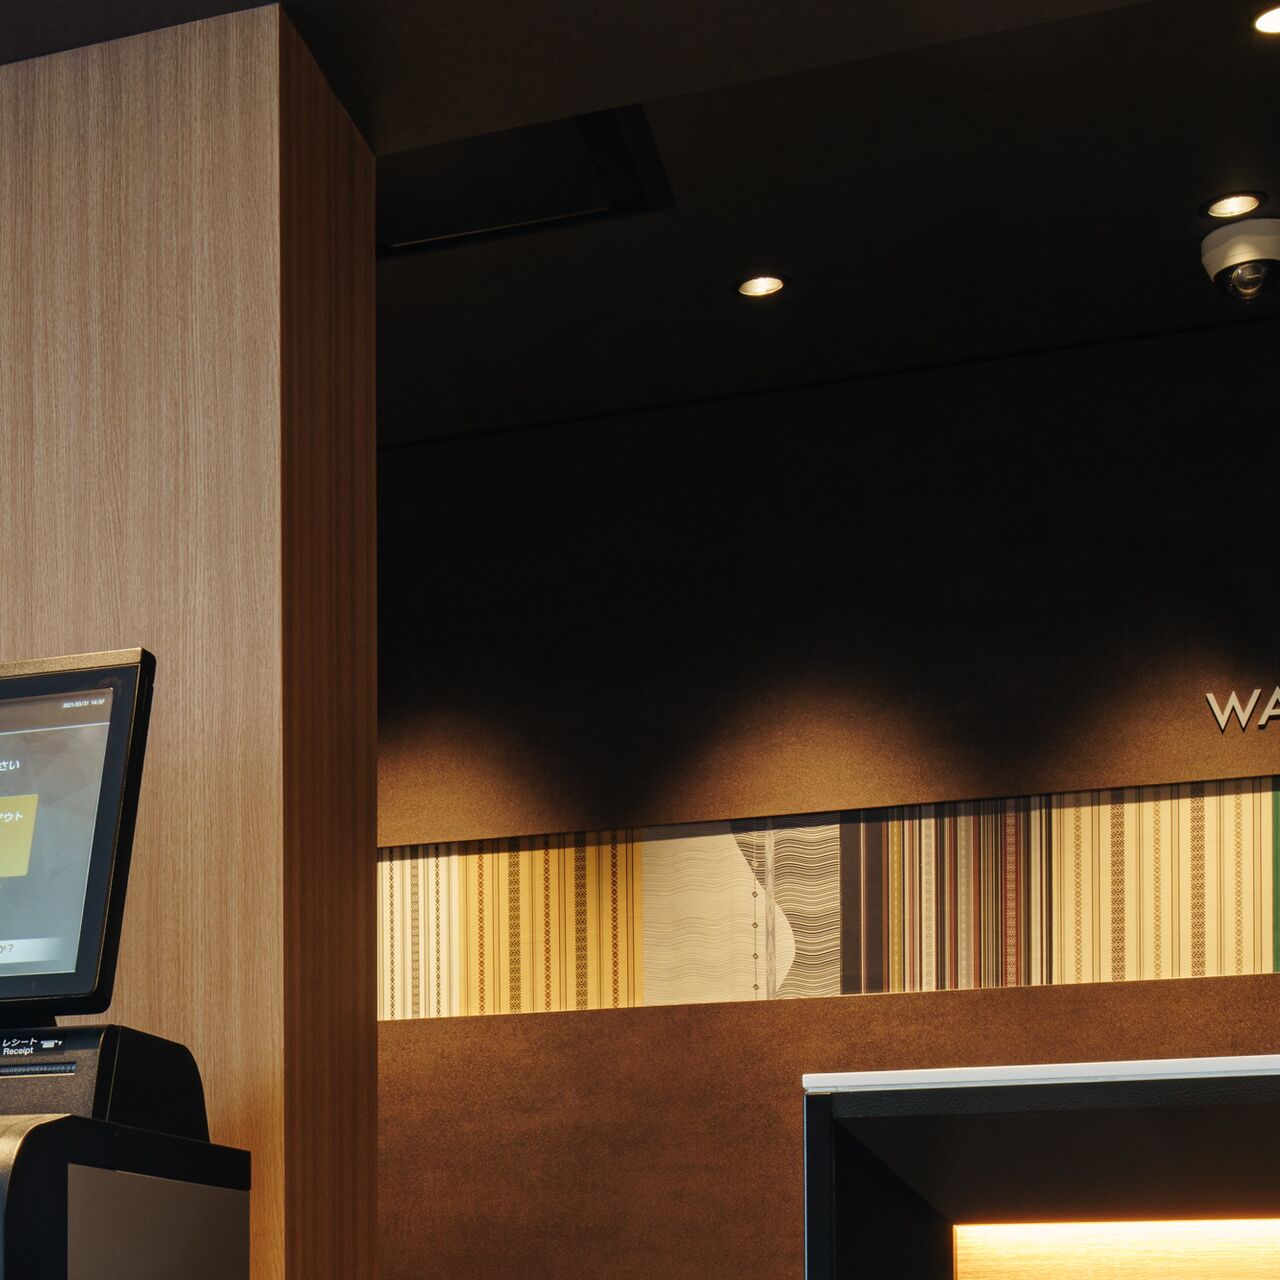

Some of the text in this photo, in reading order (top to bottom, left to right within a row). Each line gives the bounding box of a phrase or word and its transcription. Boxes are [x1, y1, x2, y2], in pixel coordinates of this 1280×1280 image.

[2, 1038, 38, 1047] レシート
[2, 1047, 34, 1056] Receipt
